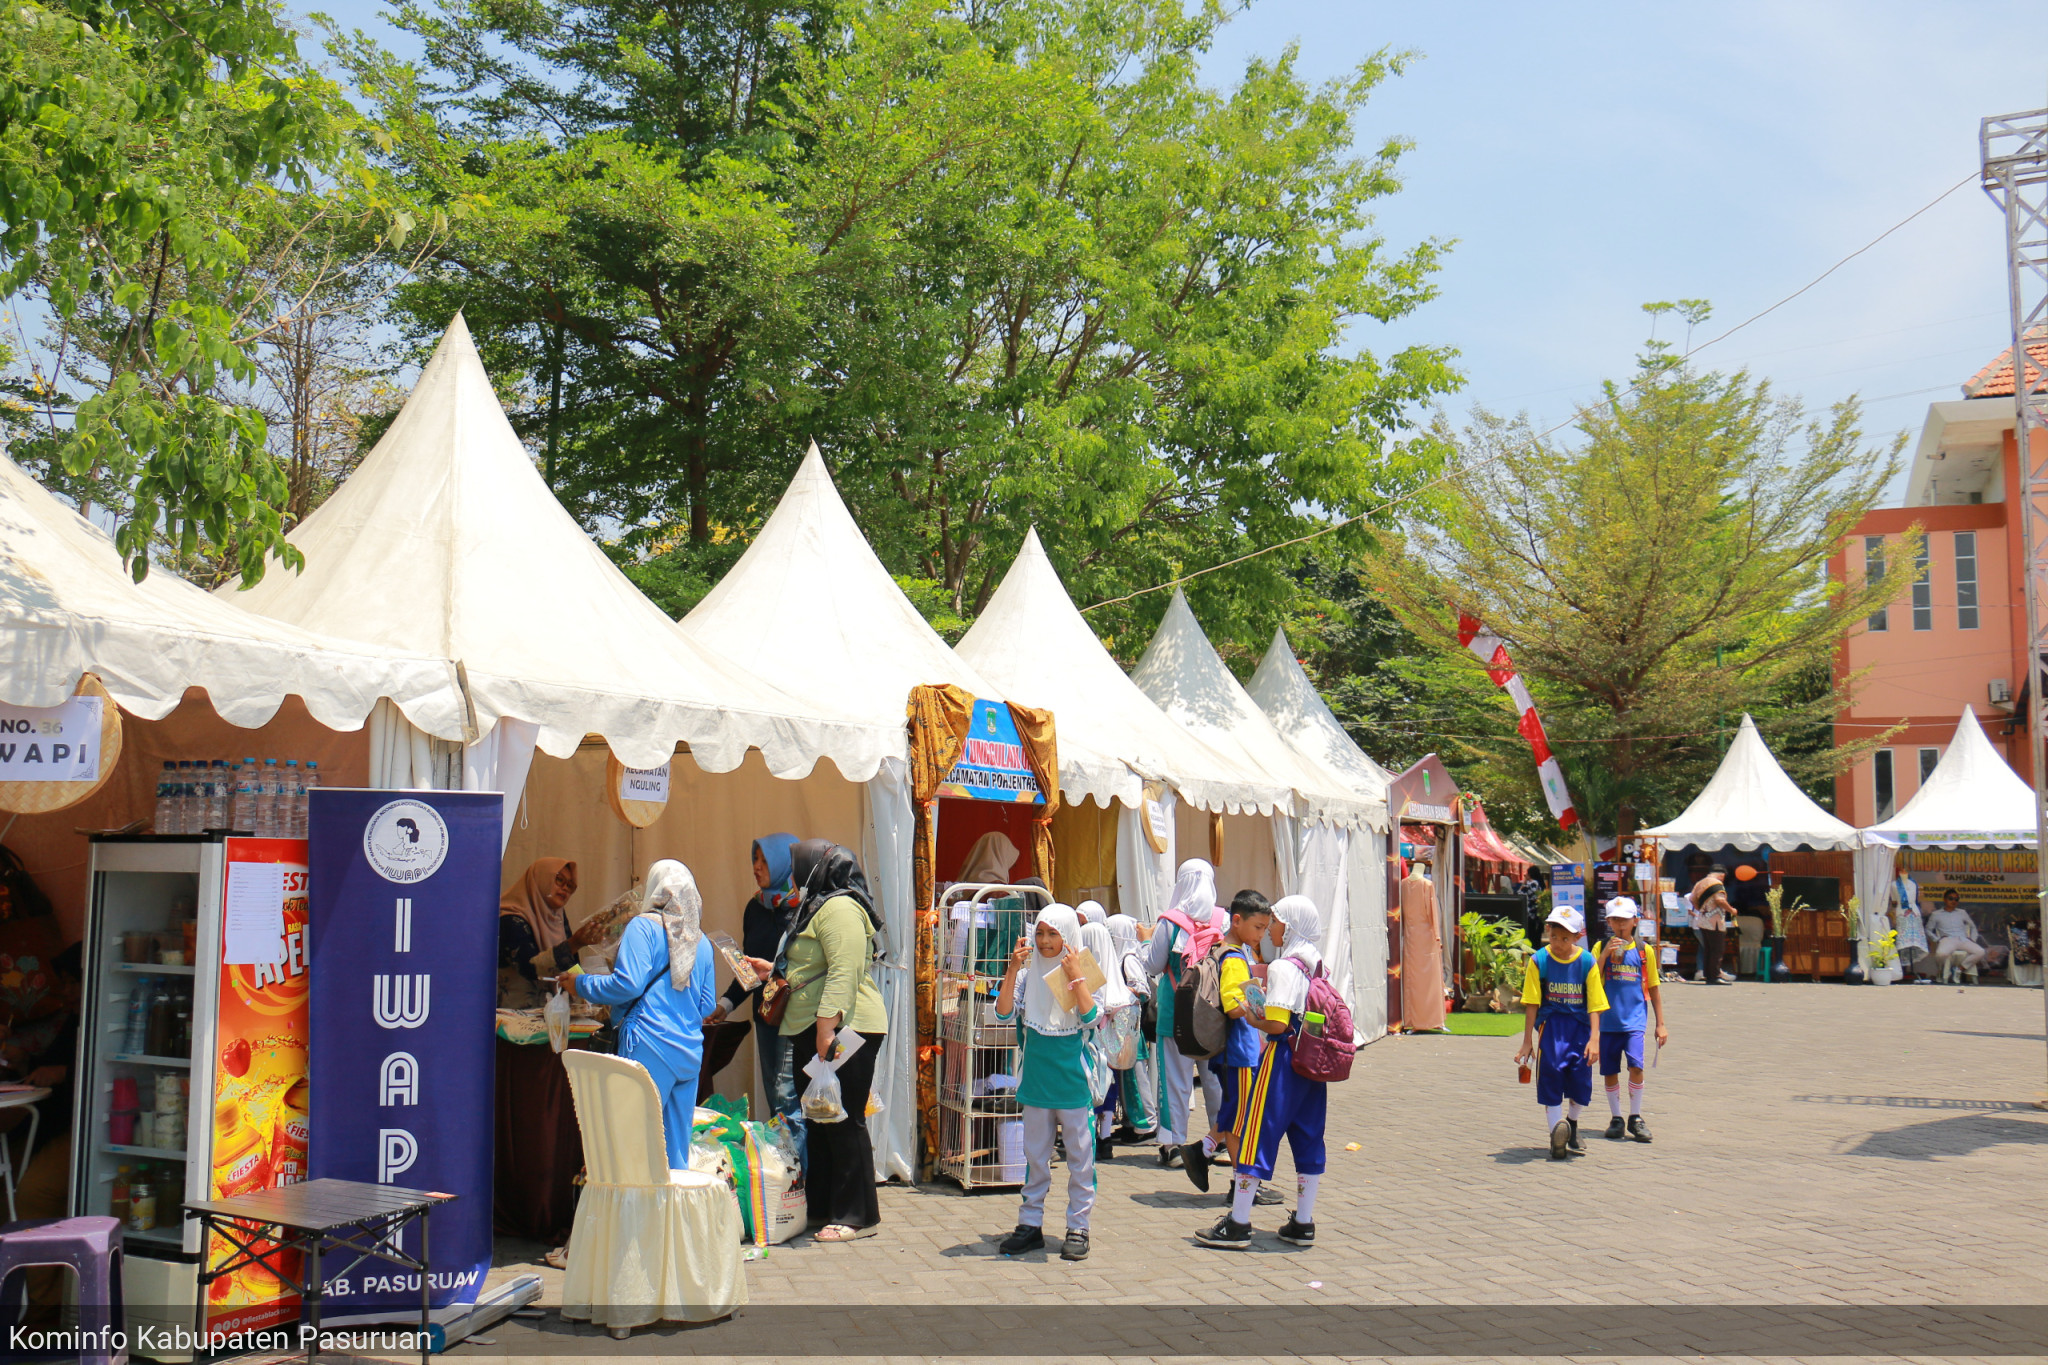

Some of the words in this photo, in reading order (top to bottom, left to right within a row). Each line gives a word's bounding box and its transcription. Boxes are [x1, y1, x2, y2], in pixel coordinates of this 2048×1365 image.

[1, 719, 36, 734] NO.
[969, 739, 1021, 770] UNGGULAN
[629, 780, 661, 791] NGULING
[1912, 852, 1966, 872] INDUSTRI
[1968, 852, 2000, 872] KECIL
[384, 866, 428, 880] IWAPI
[1549, 982, 1582, 994] GAMBIRAN
[231, 1153, 260, 1180] FIESTA
[363, 1270, 479, 1294] PASURUAN
